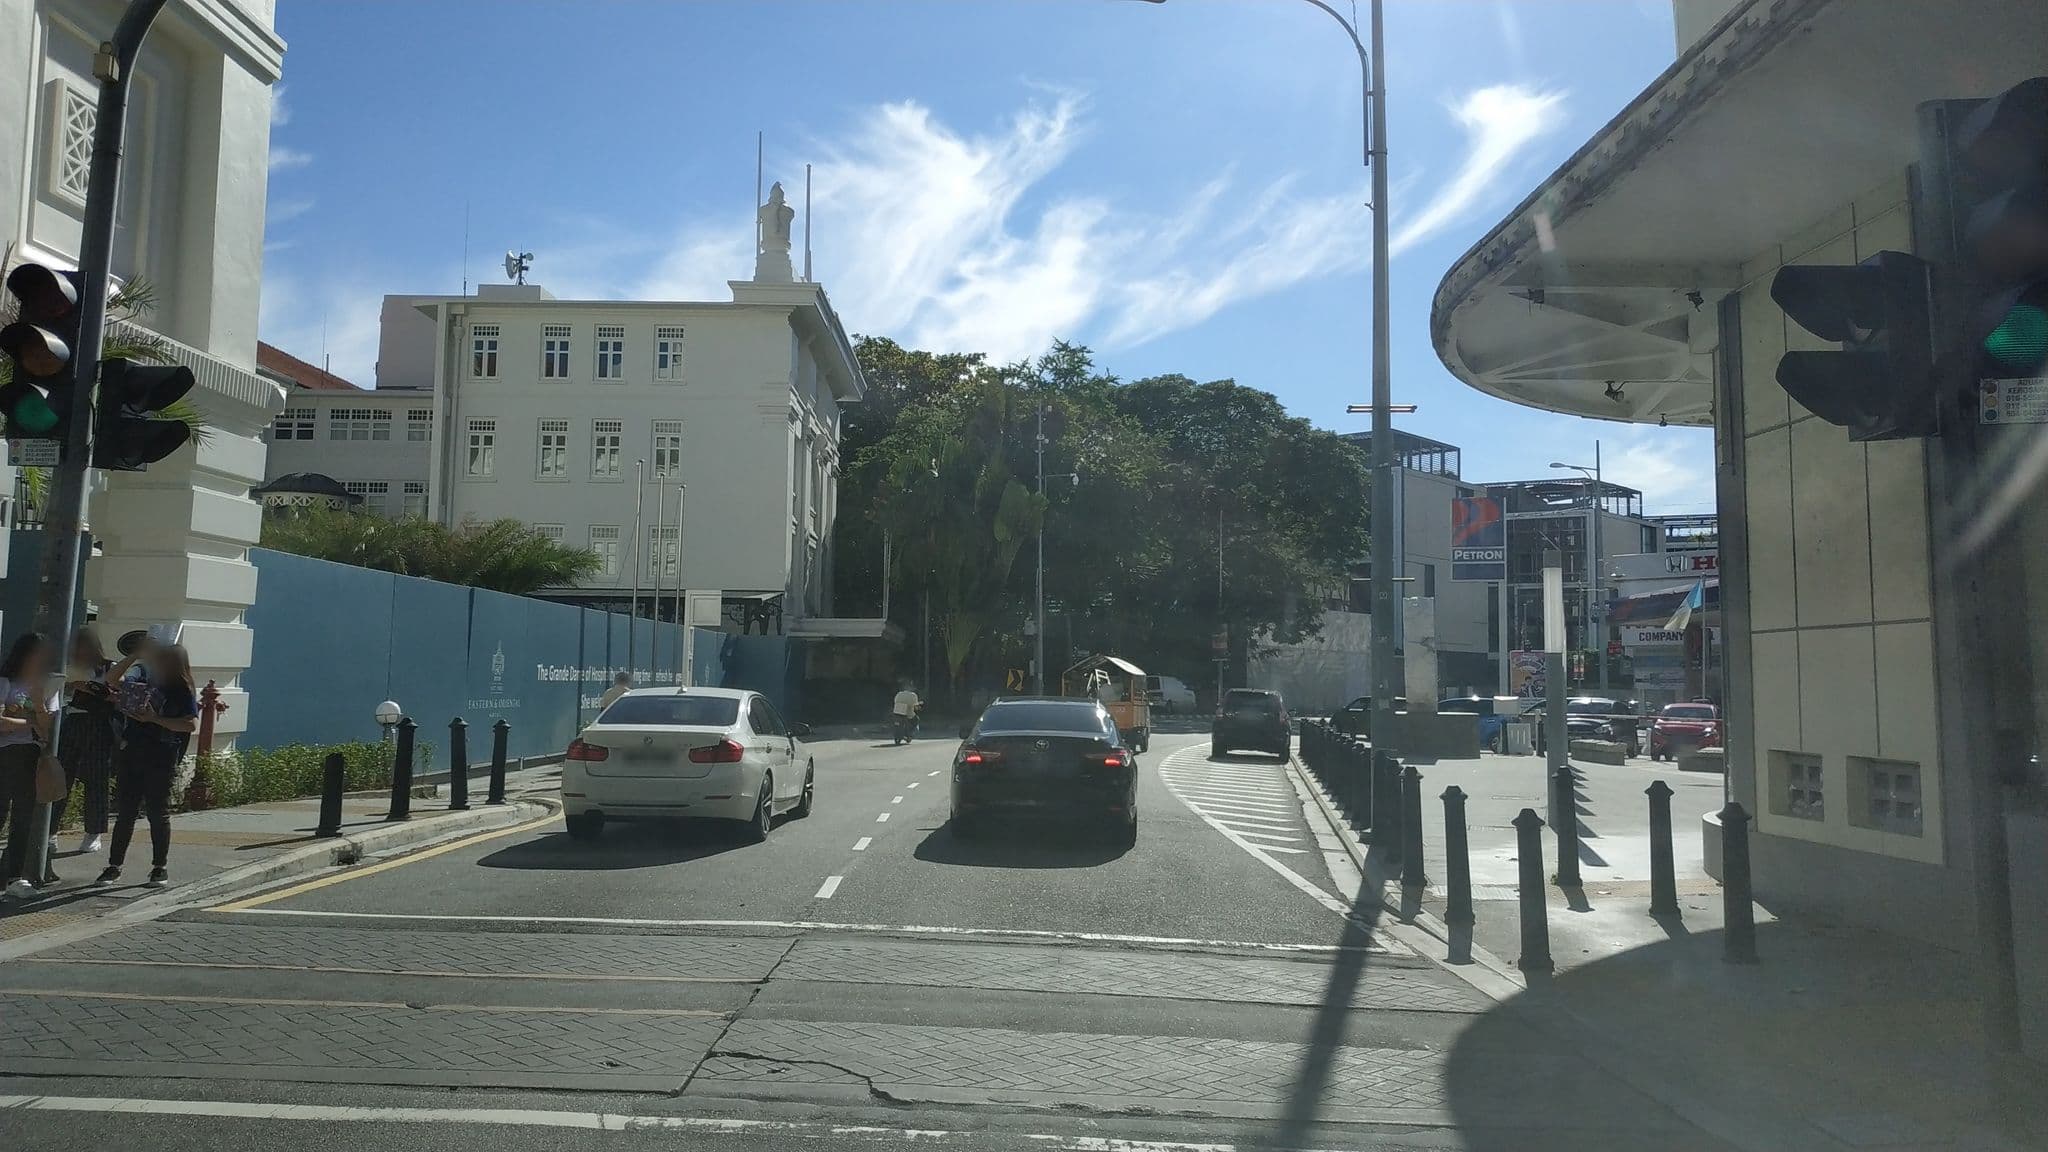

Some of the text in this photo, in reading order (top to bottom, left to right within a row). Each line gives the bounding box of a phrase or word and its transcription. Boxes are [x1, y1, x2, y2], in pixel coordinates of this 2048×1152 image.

[1454, 550, 1503, 560] PETRON
[1639, 631, 1685, 641] COMPANY
[537, 664, 548, 681] The
[549, 664, 569, 681] Grande
